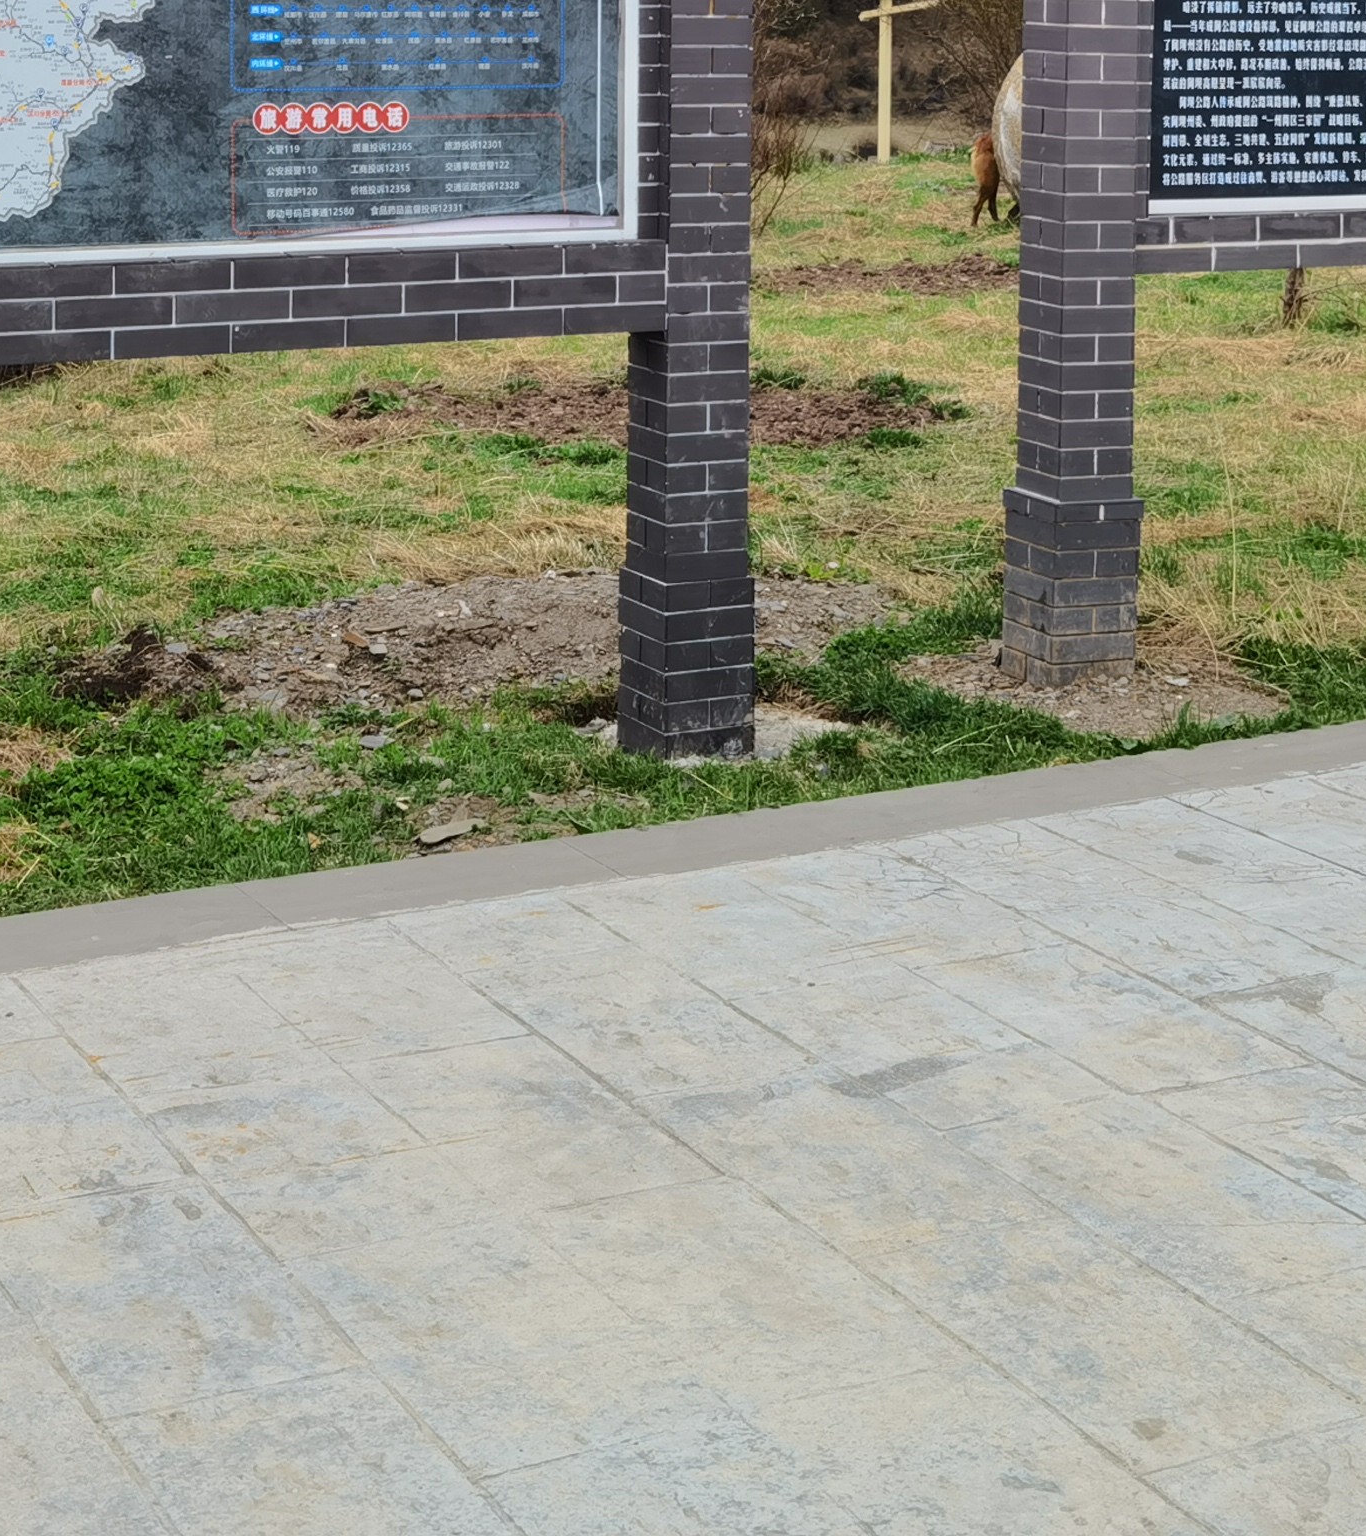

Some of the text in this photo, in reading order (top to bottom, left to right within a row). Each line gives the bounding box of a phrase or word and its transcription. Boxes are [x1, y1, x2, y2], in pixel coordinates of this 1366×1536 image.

[251, 32, 274, 42] 北环线
[258, 107, 405, 132] 旅游常用电话
[266, 144, 301, 155] 火警119
[352, 142, 413, 153] 质量投诉12365
[444, 140, 502, 151] 旅游投诉12301
[266, 165, 318, 176] 公安报警110
[350, 163, 410, 174] 工商投诉12315
[445, 161, 510, 172] 交通事故报警122
[266, 186, 318, 198] 医疗救护120
[350, 184, 411, 195] 价格投诉12358
[266, 207, 355, 219] 移动号码百事通12580
